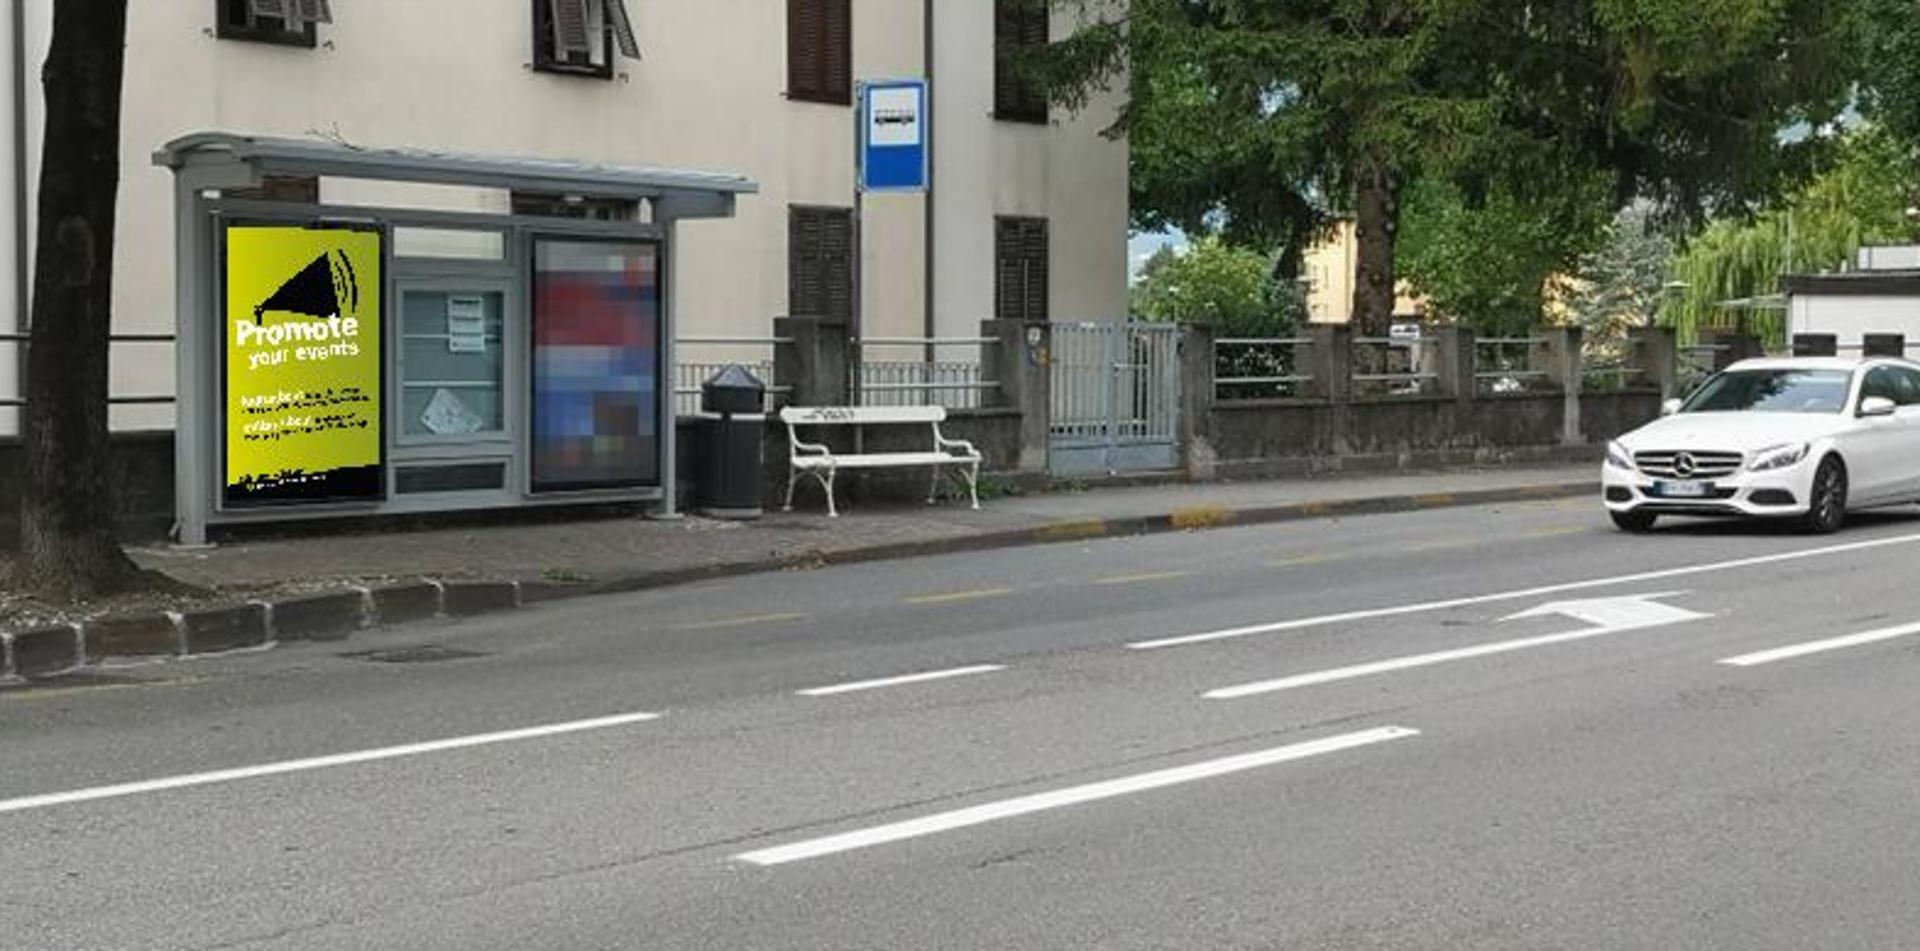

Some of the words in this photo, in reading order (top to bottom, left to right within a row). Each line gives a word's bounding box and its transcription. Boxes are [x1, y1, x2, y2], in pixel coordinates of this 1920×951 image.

[236, 313, 358, 346] Promote
[249, 349, 289, 370] your
[295, 340, 359, 360] events
